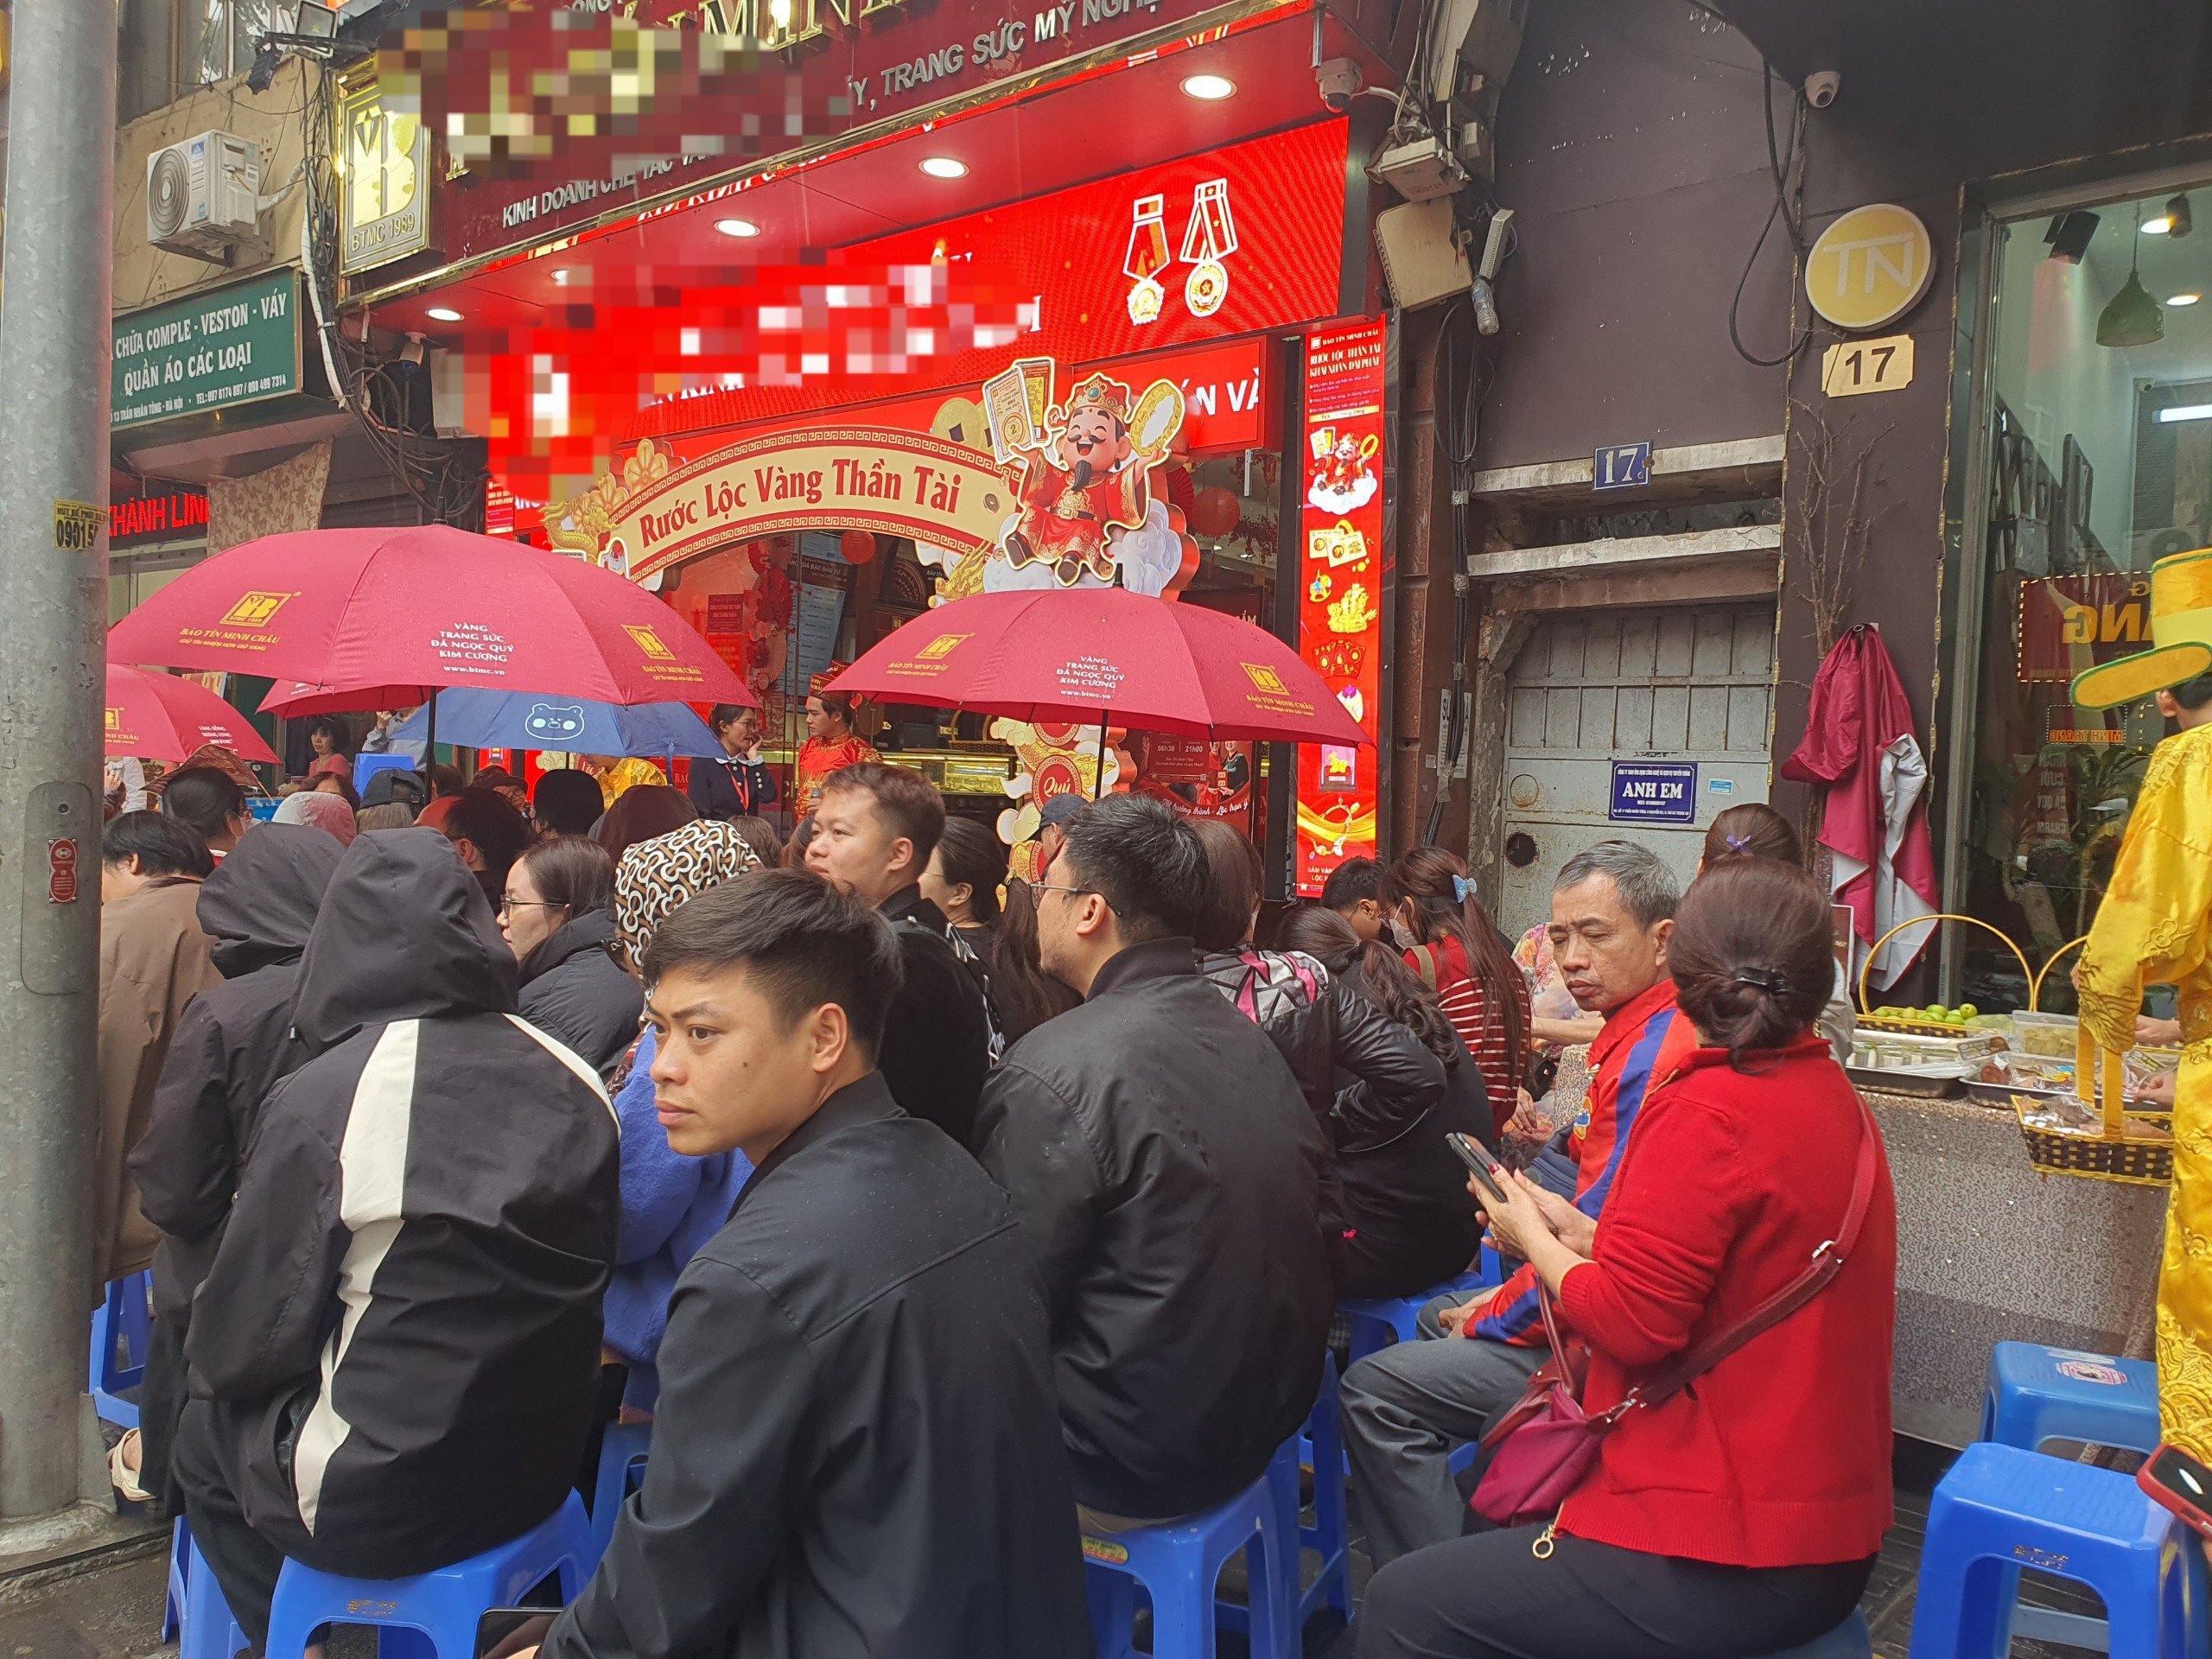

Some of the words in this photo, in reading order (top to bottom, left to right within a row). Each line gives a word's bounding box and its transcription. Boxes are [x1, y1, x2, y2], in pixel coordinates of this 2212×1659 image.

[880, 43, 963, 96] TRANG
[971, 22, 1027, 64] SỨC
[1034, 0, 1077, 43] MỸ
[1082, 0, 1159, 27] NG
[502, 195, 537, 228] KINH
[541, 179, 599, 215] DOANH
[352, 224, 386, 251] BTMC
[389, 212, 415, 239] 1989
[1822, 232, 1915, 297] TN
[116, 329, 144, 359] CHỮA
[146, 319, 191, 351] COMPLE
[200, 303, 248, 335] VESTON
[261, 288, 287, 320] VÁY
[124, 358, 159, 396] QUẦN
[164, 355, 182, 384] ÁO
[188, 346, 213, 378] CÁC
[219, 341, 251, 372] LOẠI
[1846, 346, 1896, 385] 17
[1605, 448, 1638, 484] 17
[639, 499, 699, 549] Rước
[704, 480, 747, 520] Lộc
[753, 465, 823, 505] Vàng
[830, 457, 901, 501] Thần
[912, 465, 963, 515] Tài
[454, 621, 488, 632] VÀNG
[180, 627, 202, 637] BẢO
[204, 629, 222, 638] TÍN
[222, 632, 251, 641] MINH
[251, 634, 280, 644] CHÂU
[439, 631, 480, 640] TRANG
[482, 633, 505, 642] SỨC
[431, 639, 448, 647] ĐÁ
[451, 641, 486, 651] NGỌC
[488, 644, 514, 652] QUÝ
[464, 652, 507, 663] CƯƠNG
[1080, 655, 1108, 664] VÀNG
[443, 666, 505, 675] www.btmc.vn
[1065, 662, 1098, 671] TRANG
[1082, 679, 1116, 689] CƯƠNG
[1060, 690, 1111, 699] www.btmc.vn
[1043, 777, 1071, 798] Quý
[1622, 781, 1657, 798] ANH
[1660, 782, 1683, 798] EM
